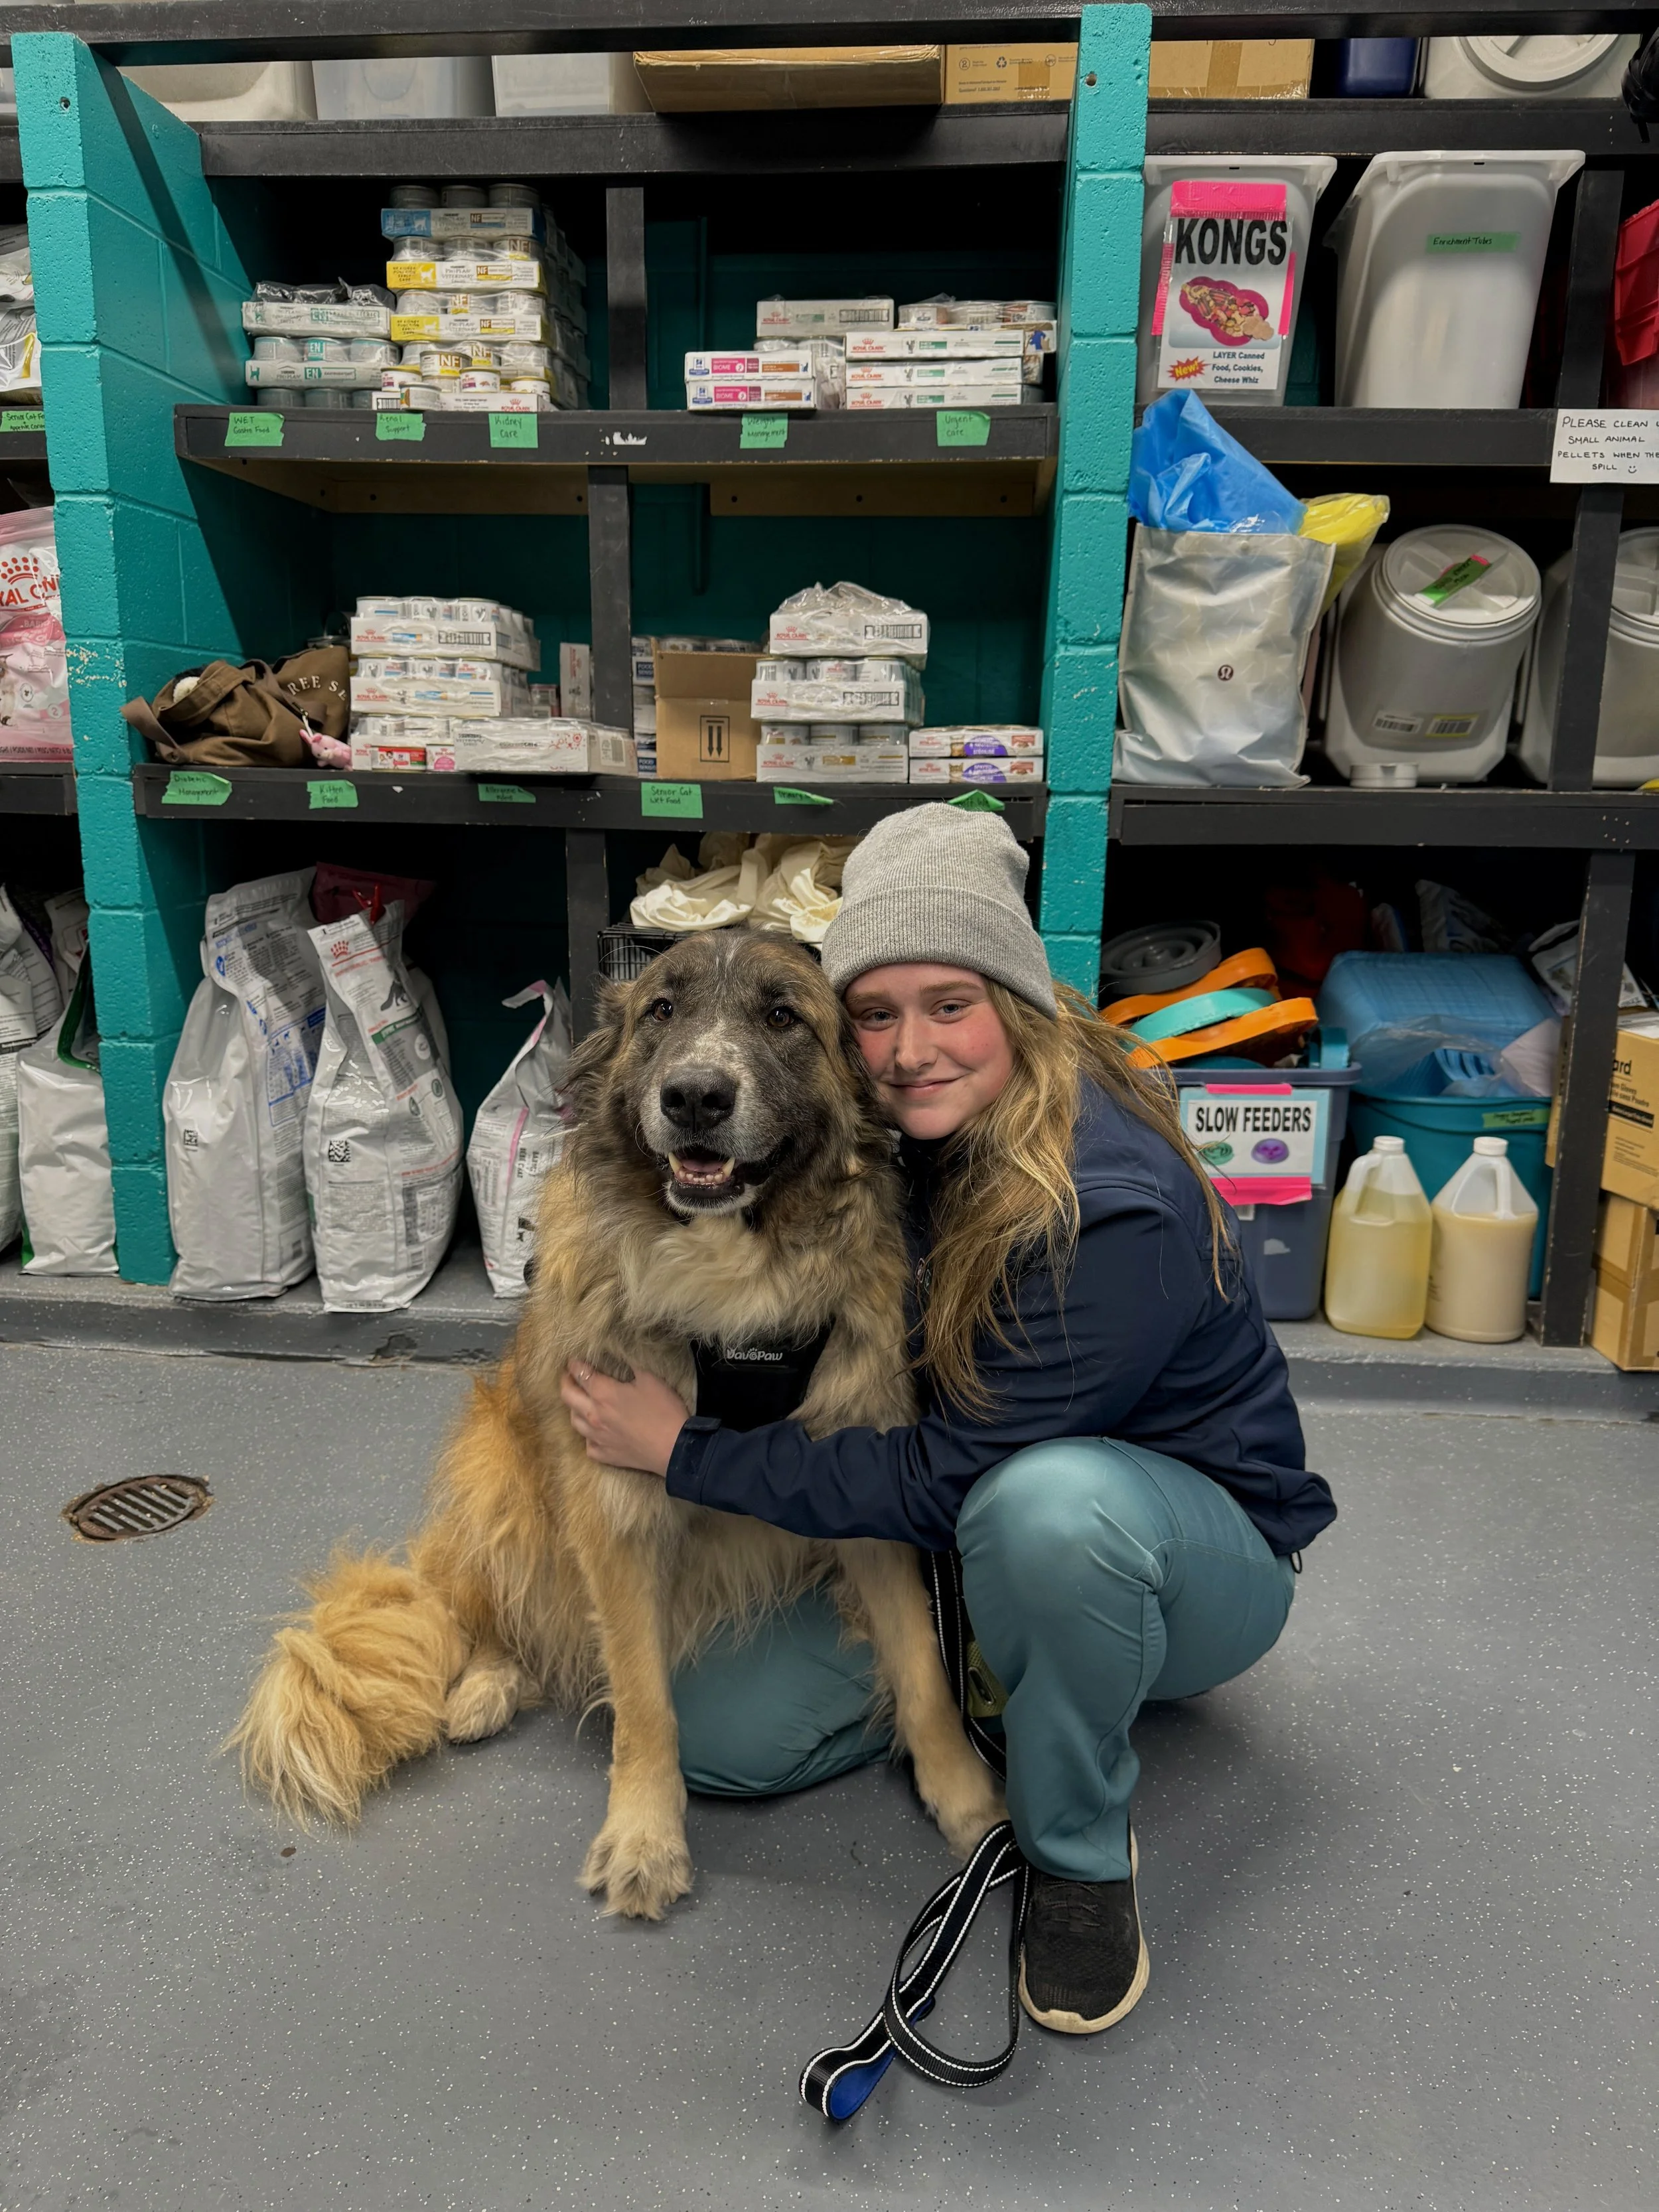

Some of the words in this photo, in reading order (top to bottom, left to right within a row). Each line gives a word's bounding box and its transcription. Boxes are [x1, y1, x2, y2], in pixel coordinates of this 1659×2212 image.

[1175, 217, 1287, 265] KONGS
[1433, 236, 1471, 246] Enrichment
[1472, 236, 1493, 246] Tubes
[440, 354, 461, 368] NF
[1238, 351, 1265, 360] Canned
[1174, 359, 1199, 377] New!
[1212, 363, 1231, 373] Food,
[1232, 363, 1263, 373] Cookies,
[234, 415, 255, 425] WET
[494, 416, 522, 429] Kidney
[944, 415, 974, 428] Urgent
[1561, 415, 1607, 428] PLEASE
[1613, 419, 1648, 428] CLEAN
[1567, 435, 1600, 445] SMALL
[1557, 450, 1605, 459] PELLETS
[651, 786, 677, 796] Senior
[679, 786, 693, 796] Cat
[1196, 1106, 1239, 1132] SLOW
[1242, 1106, 1312, 1132] FEEDERS
